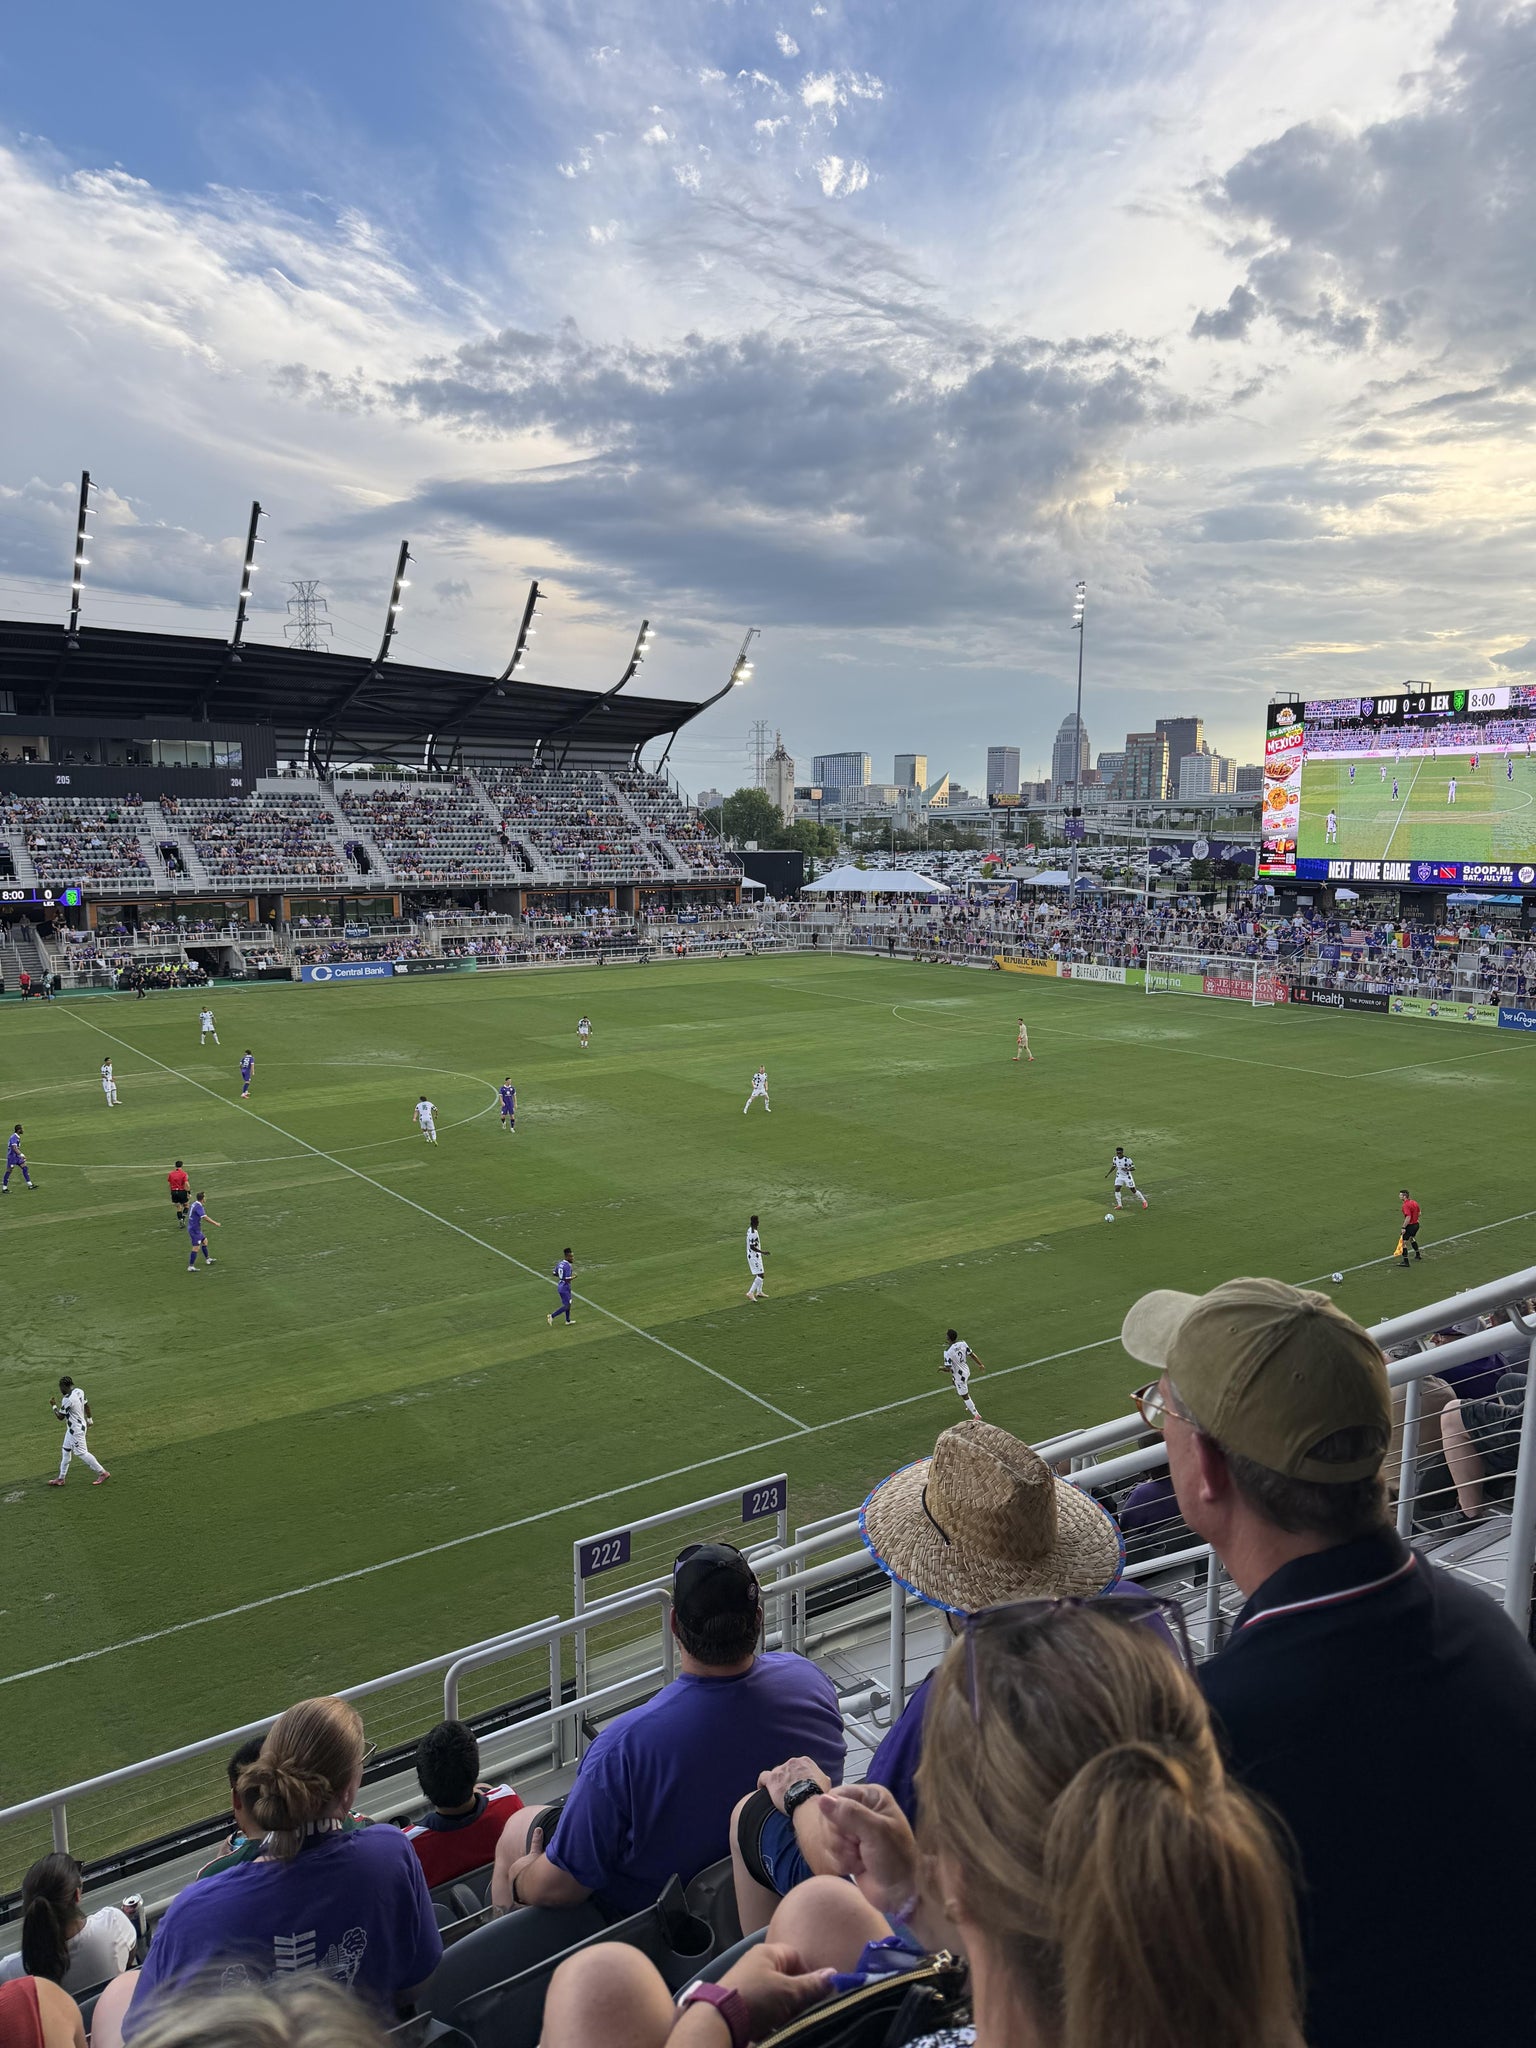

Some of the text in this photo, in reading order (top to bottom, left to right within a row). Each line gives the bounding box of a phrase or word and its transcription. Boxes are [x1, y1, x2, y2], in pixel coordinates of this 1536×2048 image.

[1377, 699, 1397, 715] LOU
[1430, 695, 1450, 711] LEX
[1471, 693, 1496, 707] 8:00
[1267, 735, 1301, 753] MEXICO
[56, 775, 71, 785] 205
[231, 778, 242, 787] 204
[1328, 861, 1352, 879] NEXT
[1353, 861, 1381, 880] HOME
[1382, 862, 1412, 881] GAME
[1462, 865, 1513, 876] 8:00P.M.
[2, 890, 25, 900] 8:00
[44, 889, 53, 900] 0
[1003, 956, 1031, 966] REPUBLIC
[1031, 959, 1048, 968] BANK
[334, 968, 364, 977] Central
[364, 966, 385, 976] Bank
[1076, 965, 1099, 979] BUFFALO
[1104, 968, 1122, 982] TRACE
[1311, 991, 1345, 1006] Health
[1358, 998, 1375, 1006] POWER
[752, 1487, 778, 1514] 223
[591, 1540, 621, 1570] 222
